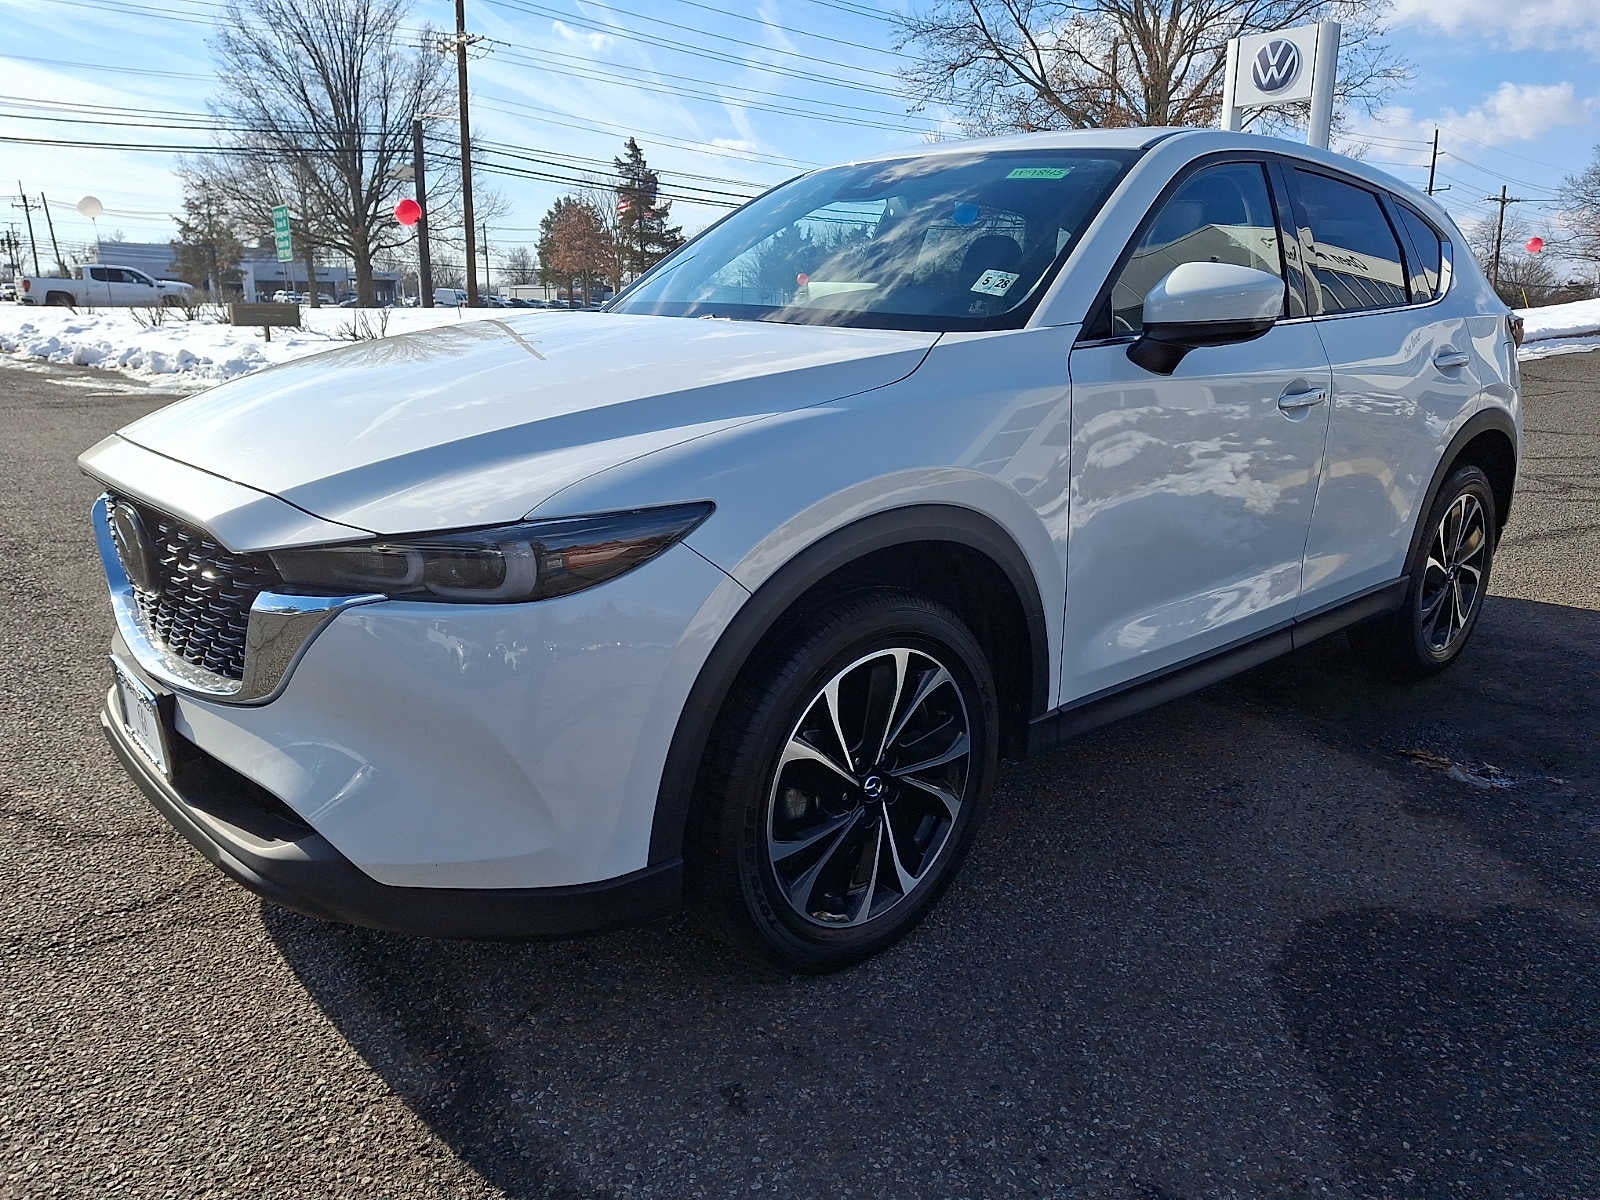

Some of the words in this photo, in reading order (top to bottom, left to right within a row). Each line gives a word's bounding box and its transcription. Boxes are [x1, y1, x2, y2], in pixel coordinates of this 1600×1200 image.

[1253, 40, 1298, 89] VW
[981, 276, 992, 285] 5
[994, 278, 1011, 289] 28
